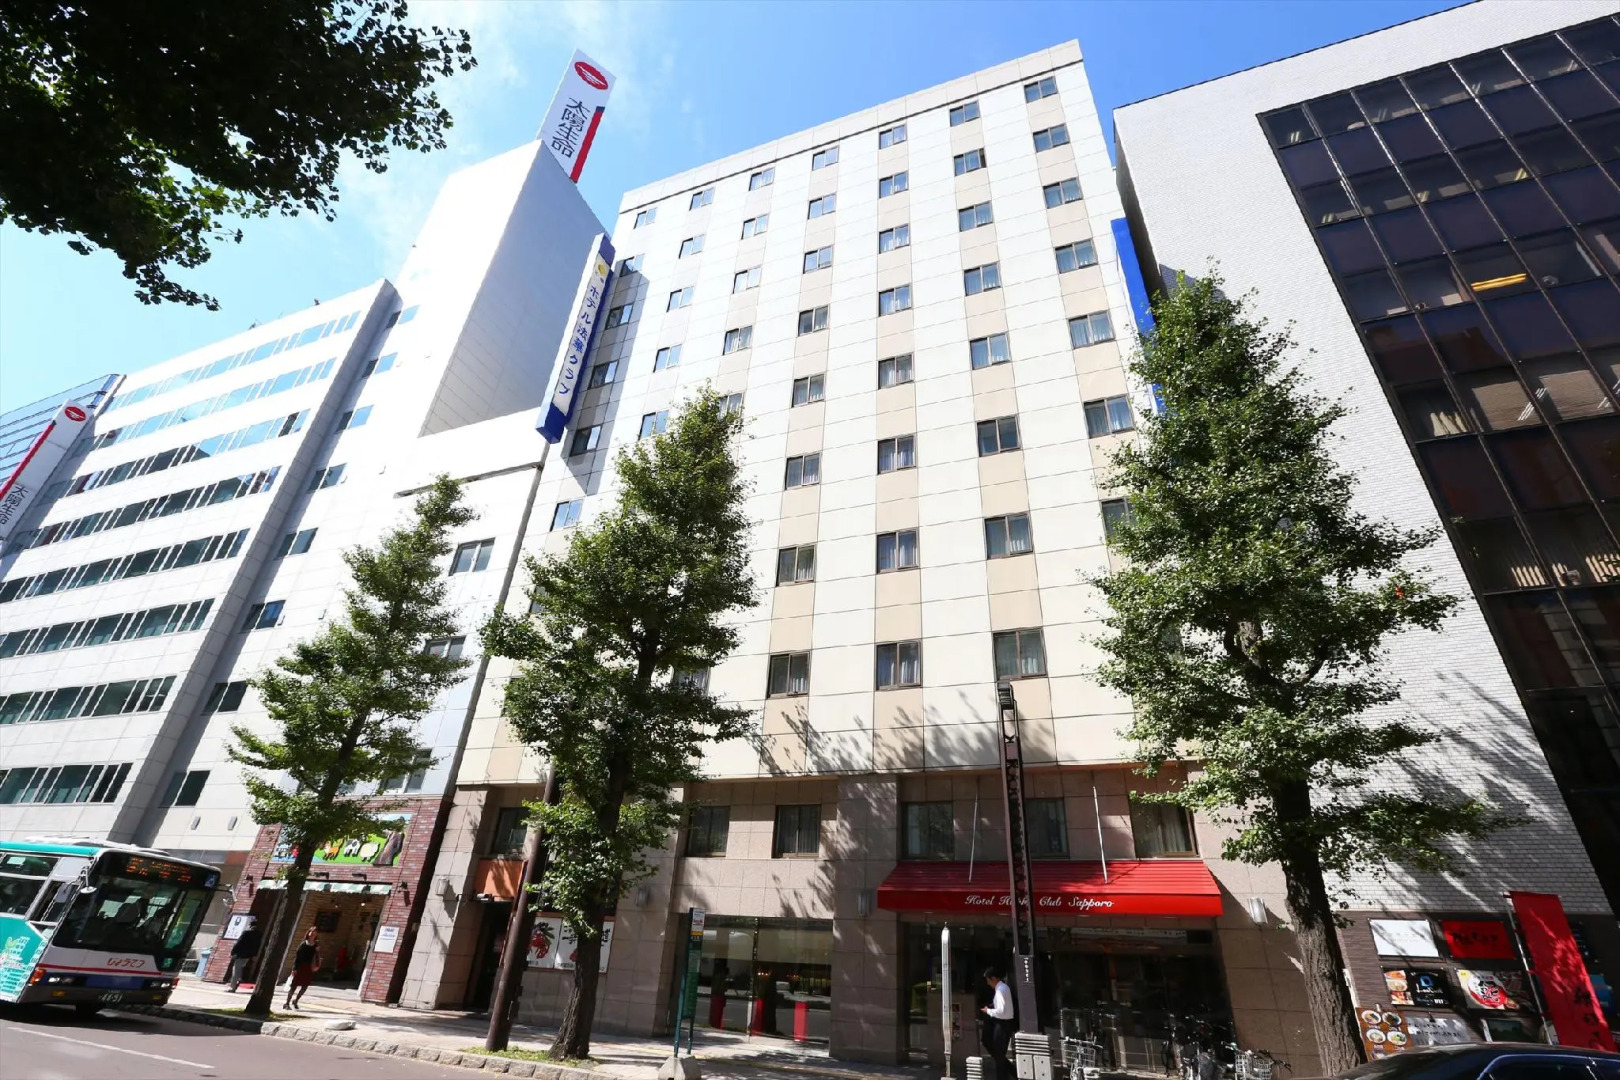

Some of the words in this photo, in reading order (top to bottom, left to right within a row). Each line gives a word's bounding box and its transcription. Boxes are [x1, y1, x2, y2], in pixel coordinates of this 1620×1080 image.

[552, 97, 590, 158] 太陽生命
[965, 895, 995, 906] Hotel
[1039, 896, 1062, 907] Club
[1068, 896, 1114, 911] Sapporo
